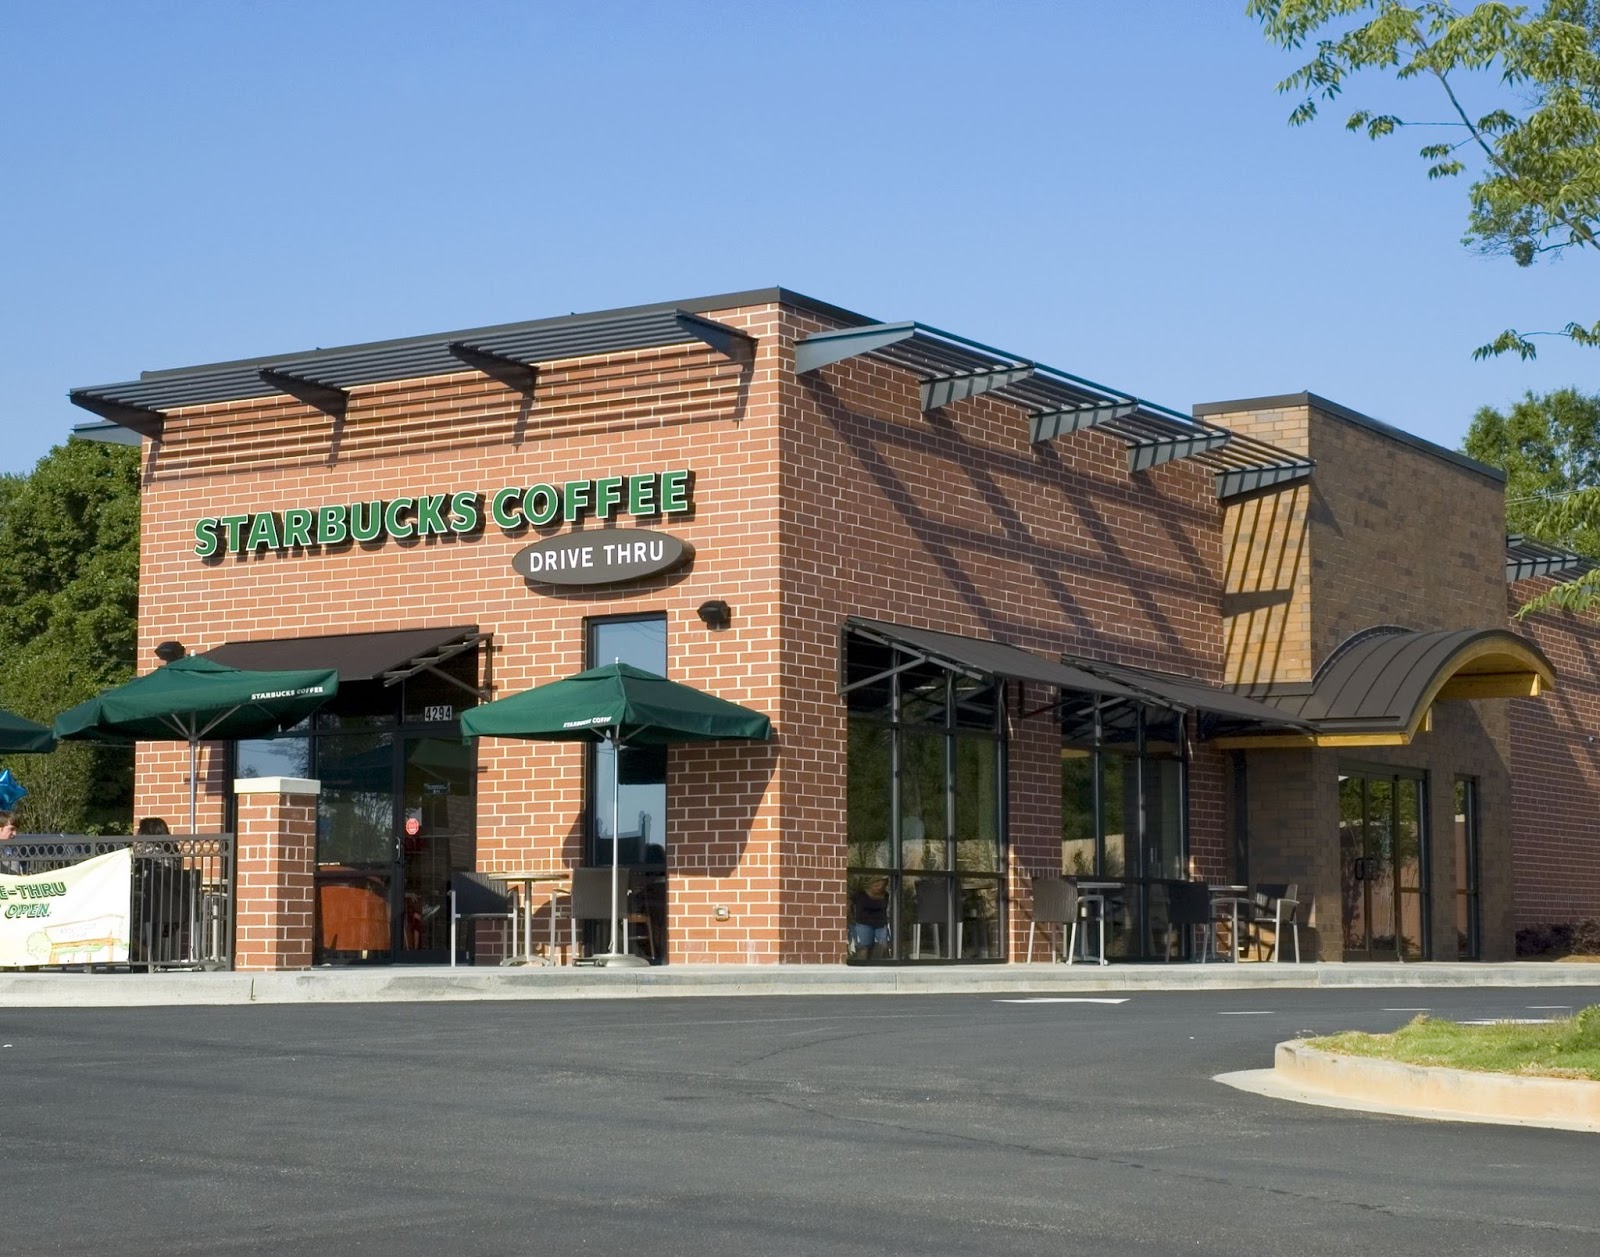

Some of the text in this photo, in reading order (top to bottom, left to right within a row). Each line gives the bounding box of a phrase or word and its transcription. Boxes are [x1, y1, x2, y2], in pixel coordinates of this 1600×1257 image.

[193, 468, 689, 557] STARBUCKS COFFEE
[530, 540, 663, 572] DRIVE THRU
[251, 686, 324, 700] STARBUCKS COFFEE
[425, 706, 451, 721] 4294
